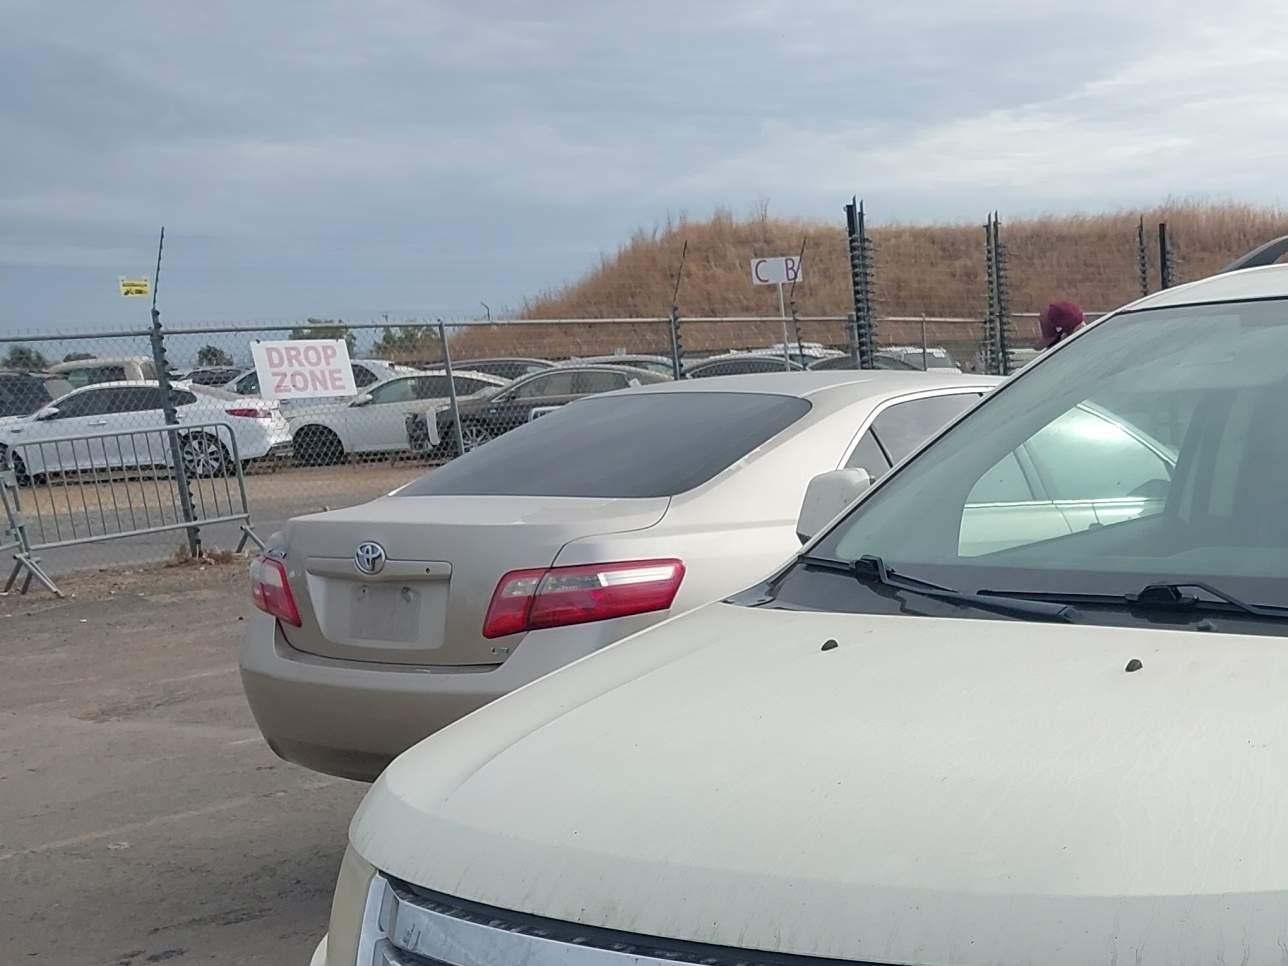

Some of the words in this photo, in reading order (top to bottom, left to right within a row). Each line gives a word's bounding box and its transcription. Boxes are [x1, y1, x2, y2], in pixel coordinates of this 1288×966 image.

[755, 259, 769, 283] C
[785, 257, 797, 281] B
[265, 345, 337, 369] DROP
[272, 369, 346, 393] ZONE
